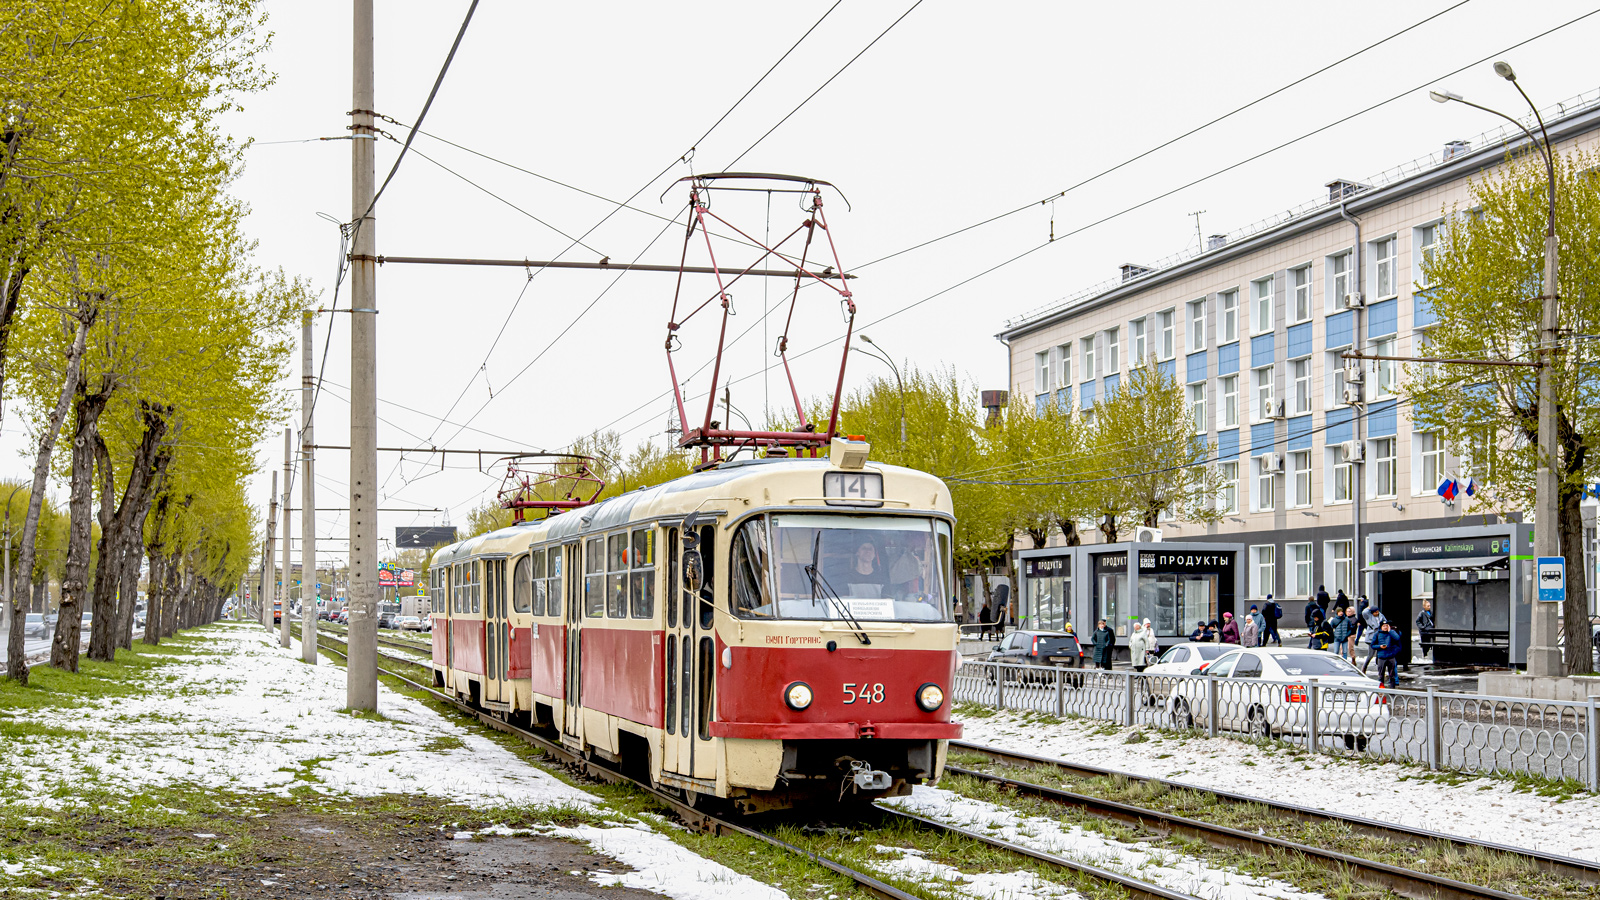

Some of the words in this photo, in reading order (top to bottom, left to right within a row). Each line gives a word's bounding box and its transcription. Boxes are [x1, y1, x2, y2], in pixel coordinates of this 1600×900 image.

[836, 474, 867, 501] 14
[1444, 544, 1474, 552] Kalininskaya
[1159, 556, 1228, 565] ПРОДУКТЫ
[1038, 561, 1063, 571] ПРОДУКТЫ
[843, 683, 886, 704] 548
